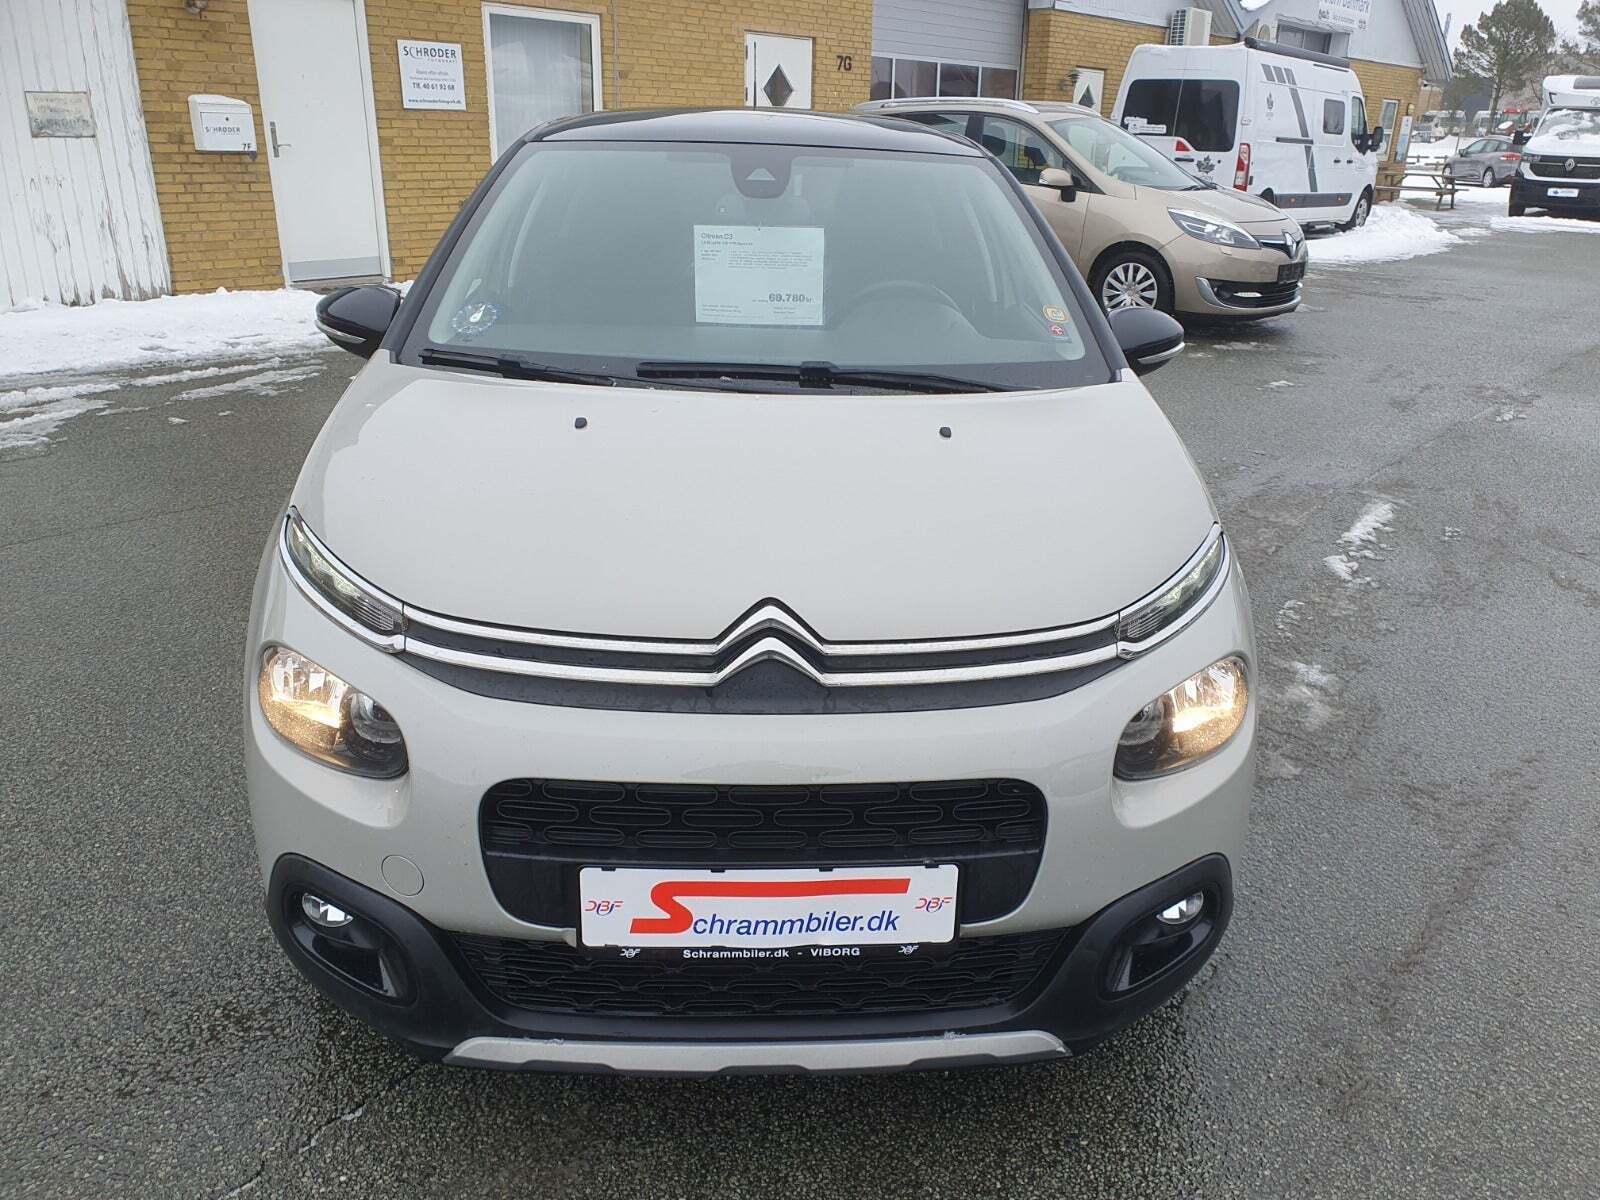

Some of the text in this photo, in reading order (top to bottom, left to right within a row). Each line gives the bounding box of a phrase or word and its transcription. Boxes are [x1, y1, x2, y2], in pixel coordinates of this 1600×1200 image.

[836, 55, 852, 71] 7G
[242, 143, 251, 151] 7F
[630, 878, 911, 935] Schrammbiler.dk
[683, 949, 789, 959] Schrammbiler.dk
[811, 948, 860, 957] VIBORG
